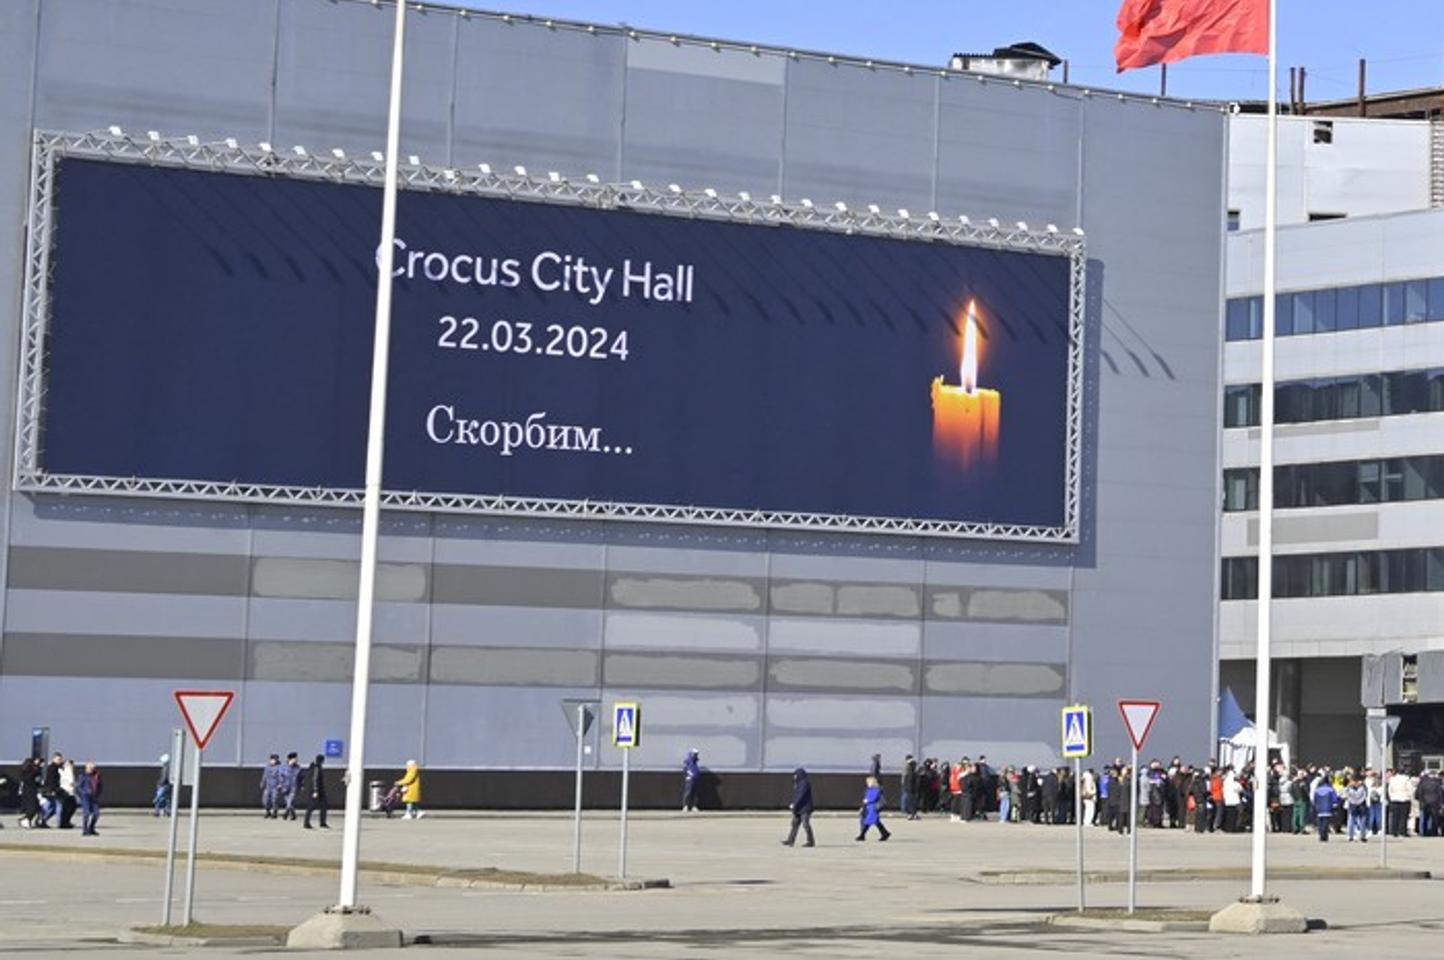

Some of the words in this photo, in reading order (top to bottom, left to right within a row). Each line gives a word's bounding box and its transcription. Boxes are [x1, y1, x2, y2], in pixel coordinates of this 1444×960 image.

[375, 238, 521, 287] Crocus
[531, 252, 613, 305] City
[622, 260, 694, 302] Hall
[438, 316, 629, 360] 22.03.2024
[426, 405, 633, 455] Скорбим...
